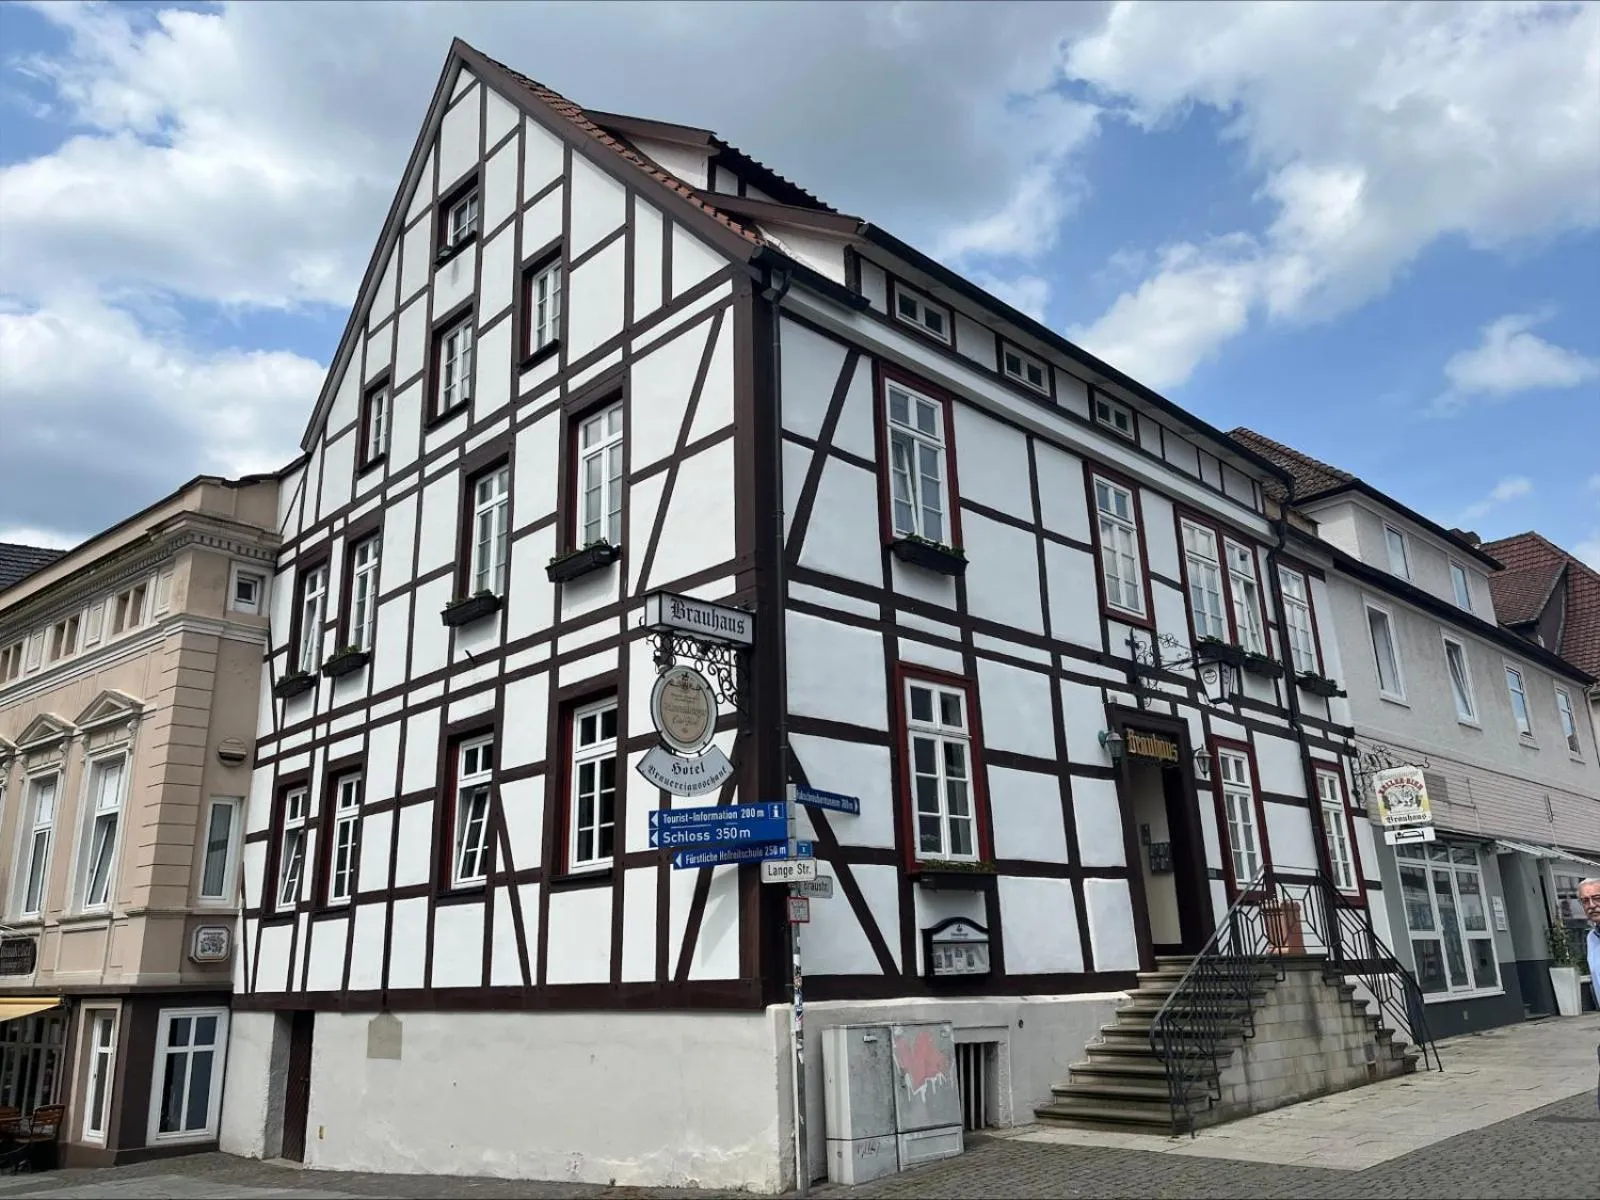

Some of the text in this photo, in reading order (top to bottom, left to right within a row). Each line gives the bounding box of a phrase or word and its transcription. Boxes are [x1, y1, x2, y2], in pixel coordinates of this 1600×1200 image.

[671, 598, 744, 634] Brauhaus
[1126, 727, 1178, 762] Brauhaus
[672, 761, 705, 775] Hotel
[663, 810, 738, 824] Tourist-Information
[741, 807, 755, 819] 200
[757, 808, 764, 817] m
[663, 827, 751, 844] Schloss 350 m
[685, 851, 718, 864] Fürstliche
[719, 847, 763, 860] Hofreitschule
[779, 845, 787, 854] m
[768, 863, 811, 878] Lange Str.
